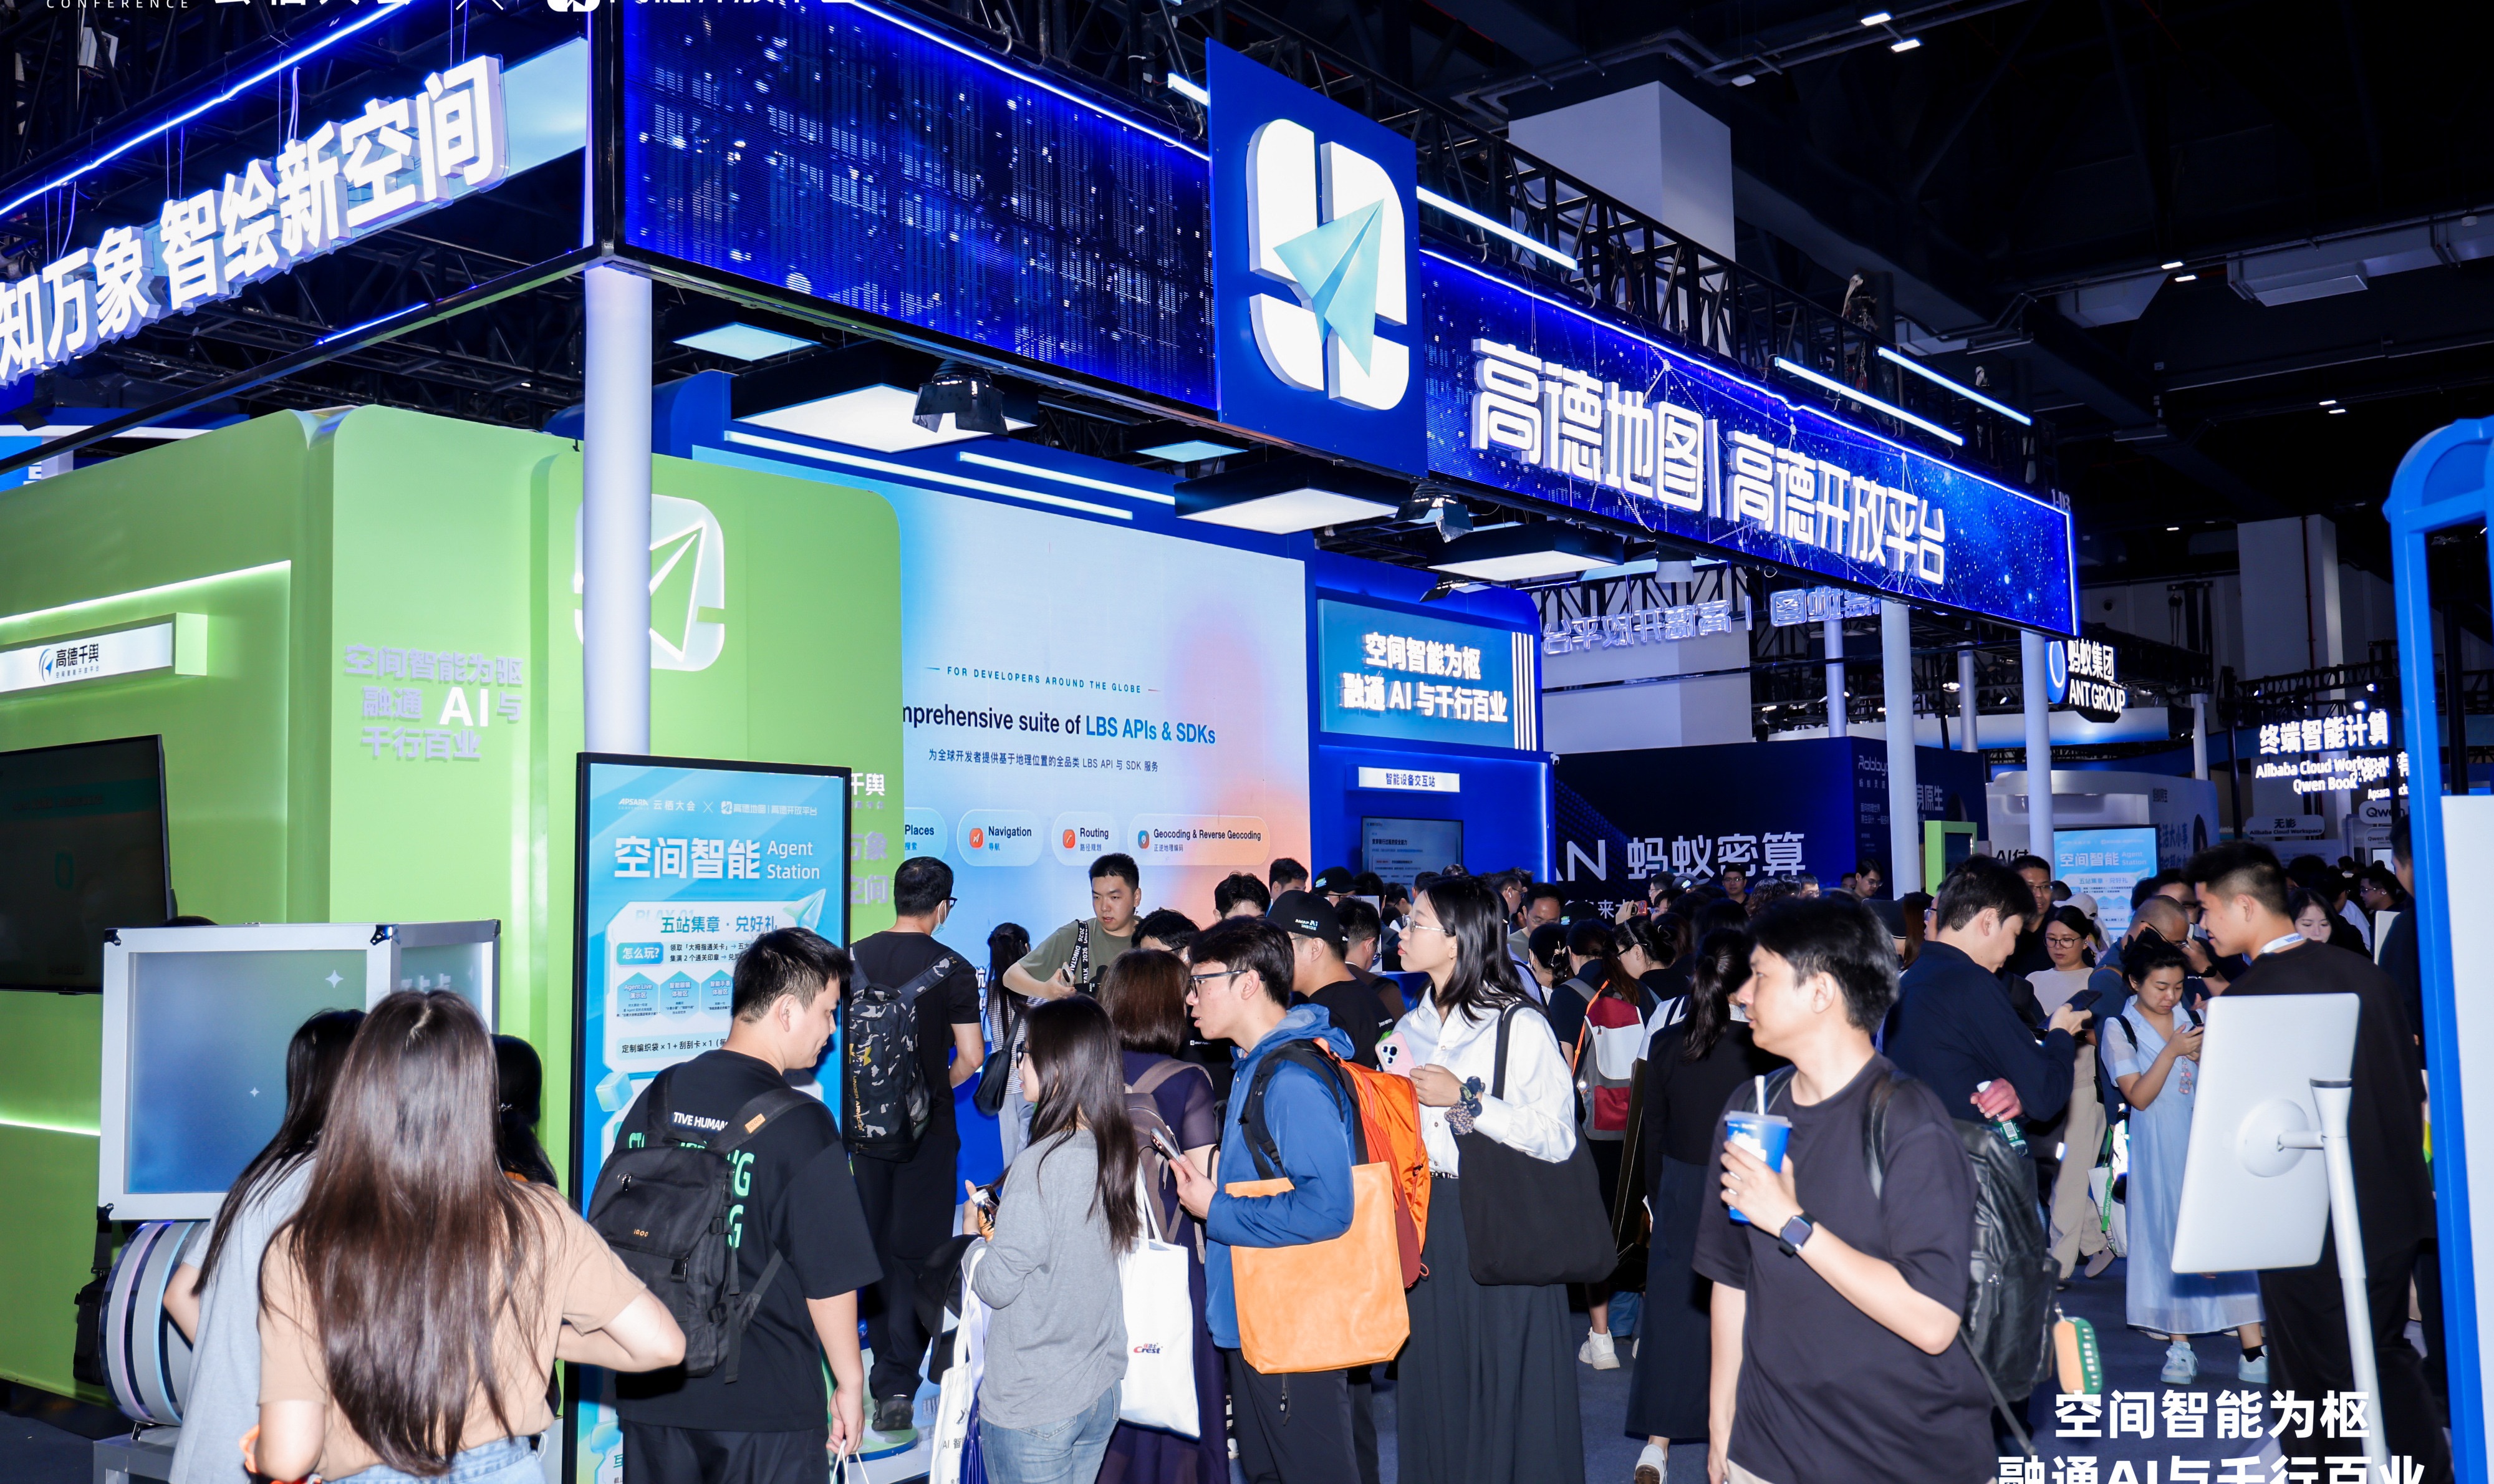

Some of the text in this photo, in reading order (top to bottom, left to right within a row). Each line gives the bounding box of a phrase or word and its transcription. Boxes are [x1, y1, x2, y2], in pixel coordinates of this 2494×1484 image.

[160, 55, 501, 310] 智绘新空间
[1473, 339, 1945, 586] 高德地图 高德开放平台
[344, 643, 524, 684] 空间智能为驱
[1365, 632, 1482, 680] 空间智能为枢
[2068, 638, 2114, 680] 蚂蚁集团
[947, 667, 1140, 693] FOR DEVELOPERS AROUND THE GLOBE
[1342, 671, 1508, 723] 融通 AI 与千行百业
[2069, 678, 2126, 713] ANT GROUP
[362, 687, 524, 727] 融通 AI 与
[1019, 711, 1059, 734] suite
[1065, 715, 1081, 735] of
[1086, 715, 1118, 737] LBS
[1122, 718, 1157, 740] APIs
[1162, 721, 1172, 741] &
[1176, 722, 1216, 744] SDKs
[2259, 710, 2389, 754] 终端智能计算
[362, 726, 482, 759] 千行百业
[929, 748, 1158, 773] 为全球开发者提供基于地理位置的全品类 LBS API 与 SDK 服务
[2255, 762, 2298, 778] Alibaba
[2299, 758, 2332, 774] Cloud
[2334, 755, 2389, 773] Workspac
[1385, 771, 1436, 788] 智能设备交互站
[2293, 777, 2326, 795] Qwen
[619, 798, 649, 806] APSARA
[653, 799, 696, 811] 云栖大会
[905, 824, 934, 836] Places
[988, 826, 1032, 838] Navigation
[2274, 818, 2296, 829] 无影
[1080, 827, 1109, 840] Routing
[1153, 829, 1261, 841] Geocoding & Reverse Geocoding
[614, 836, 761, 879] 空间智能
[768, 840, 813, 859] Agent
[1627, 831, 1806, 880] 蚂蚁密算
[2059, 852, 2119, 867] 空间智能
[768, 864, 820, 879] Station
[660, 915, 778, 933] 五站集章 兑好礼
[622, 947, 660, 960] 怎么玩?
[622, 1042, 659, 1053] 定制编织袋
[679, 1039, 701, 1050] 刮刮卡
[674, 1112, 693, 1126] TIVE
[1134, 1346, 1161, 1354] Crest
[942, 1440, 950, 1449] AI
